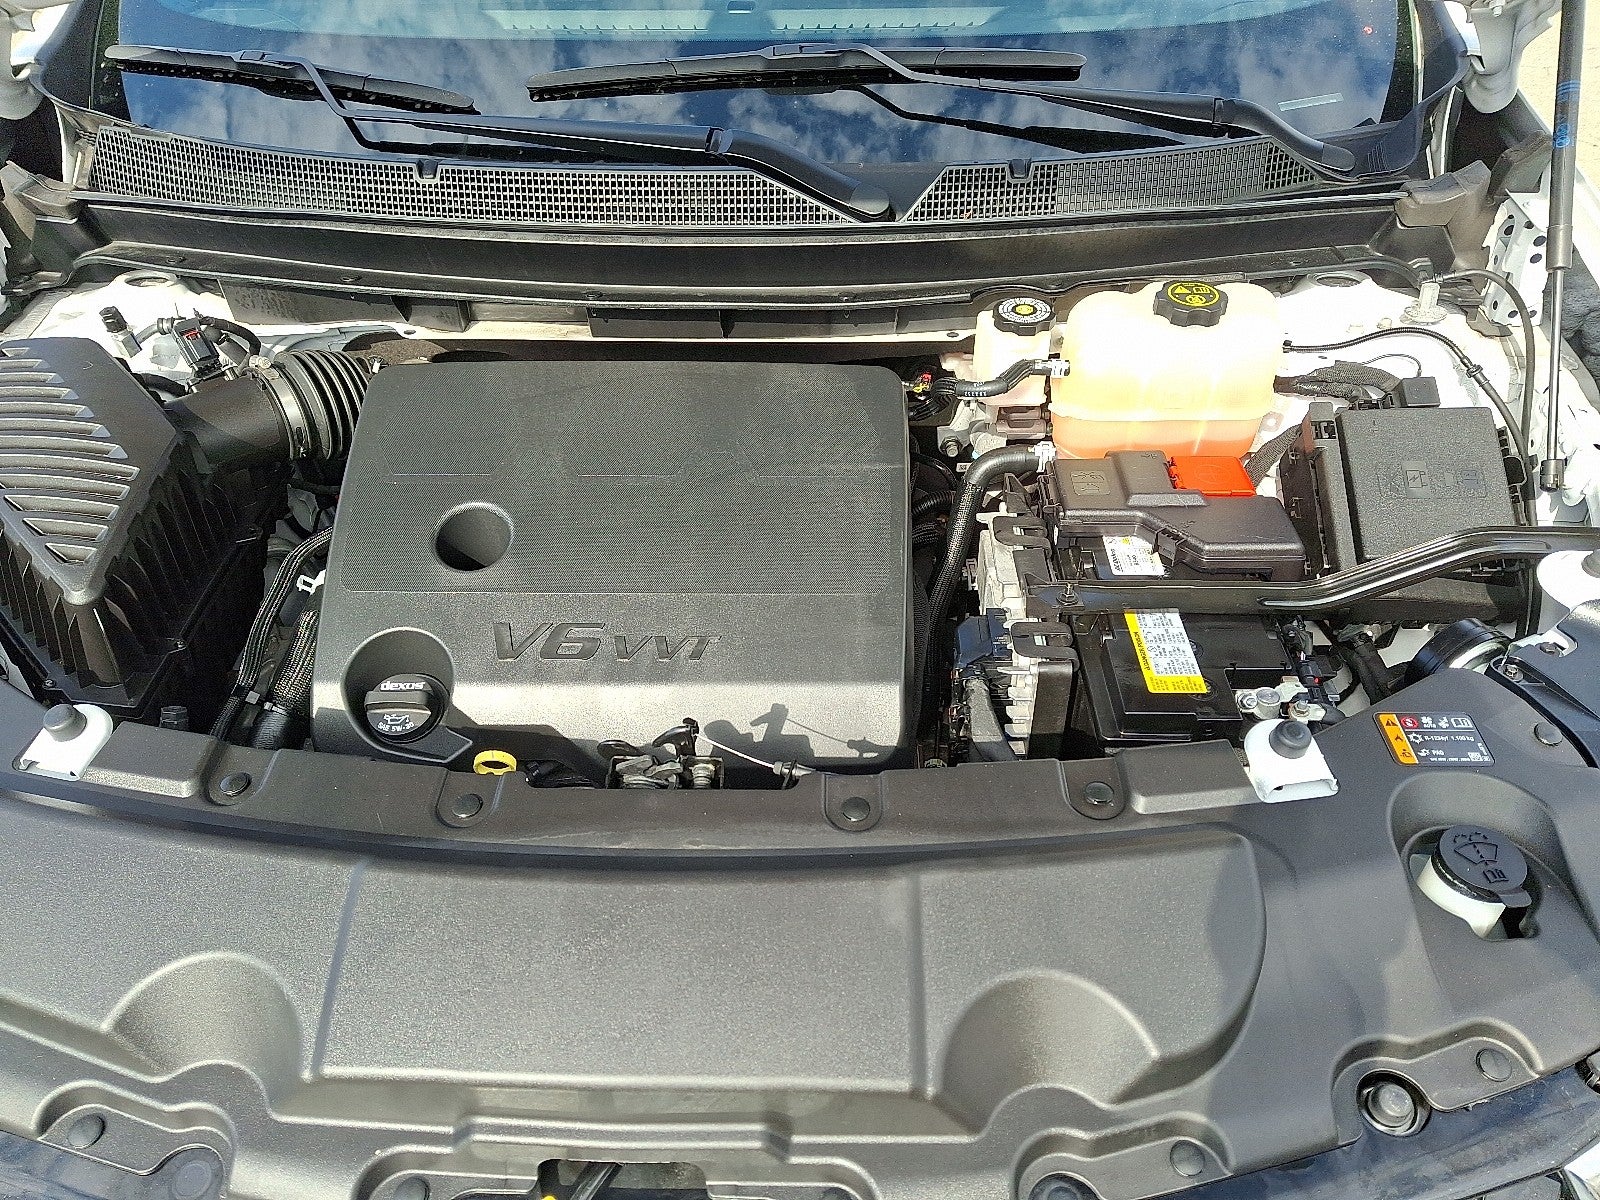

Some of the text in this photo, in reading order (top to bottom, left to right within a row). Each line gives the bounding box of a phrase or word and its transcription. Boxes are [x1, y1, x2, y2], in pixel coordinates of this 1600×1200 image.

[493, 622, 723, 661] V6 VVT
[380, 680, 426, 691] dexos
